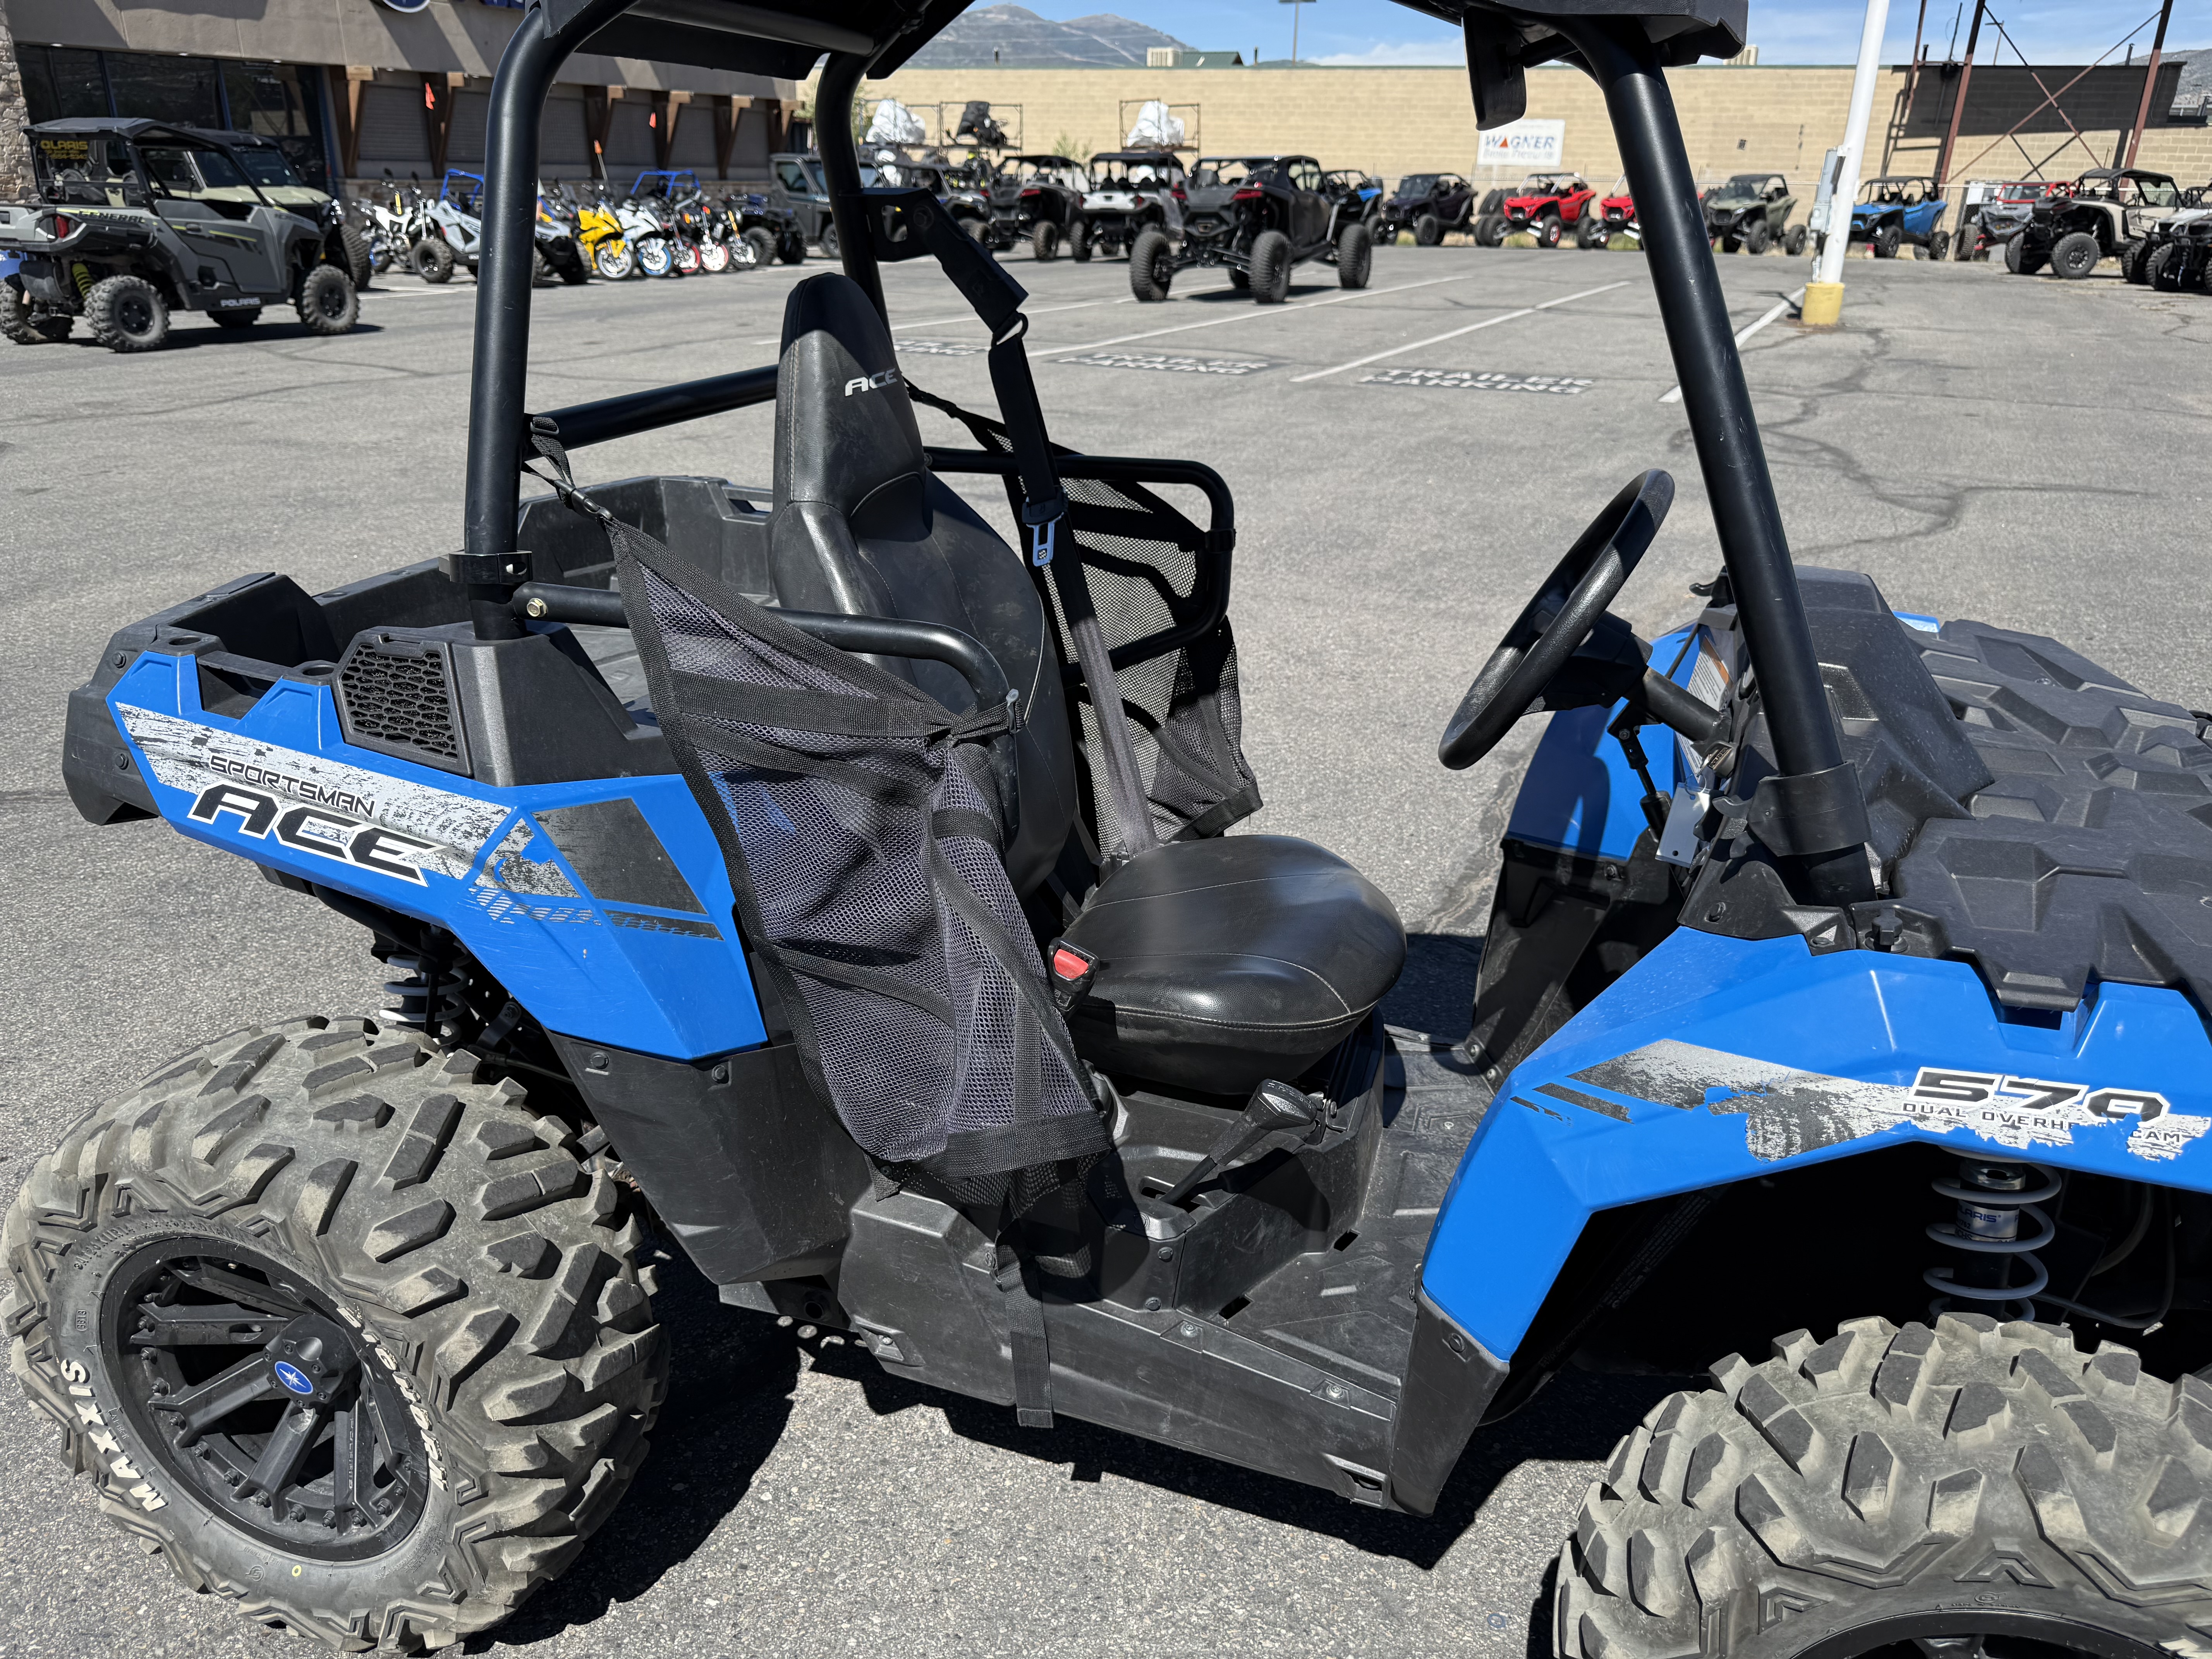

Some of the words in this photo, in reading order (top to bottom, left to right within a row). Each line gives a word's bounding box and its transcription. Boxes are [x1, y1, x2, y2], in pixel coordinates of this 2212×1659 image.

[1486, 134, 1554, 149] WAGNER
[78, 210, 145, 223] GENERAL
[220, 297, 261, 307] POLARIS
[845, 368, 898, 397] ACE
[1358, 374, 1583, 394] PARKING
[1386, 368, 1594, 386] TRAILER
[210, 755, 376, 818] SPORTSMAN
[190, 782, 440, 885] ACE
[1911, 1069, 2167, 1125] 570
[1903, 1103, 1966, 1118] DUAL
[2130, 1130, 2180, 1143] CAM
[337, 1307, 448, 1491] BIGHORN
[61, 1359, 168, 1513] MAXXIS
